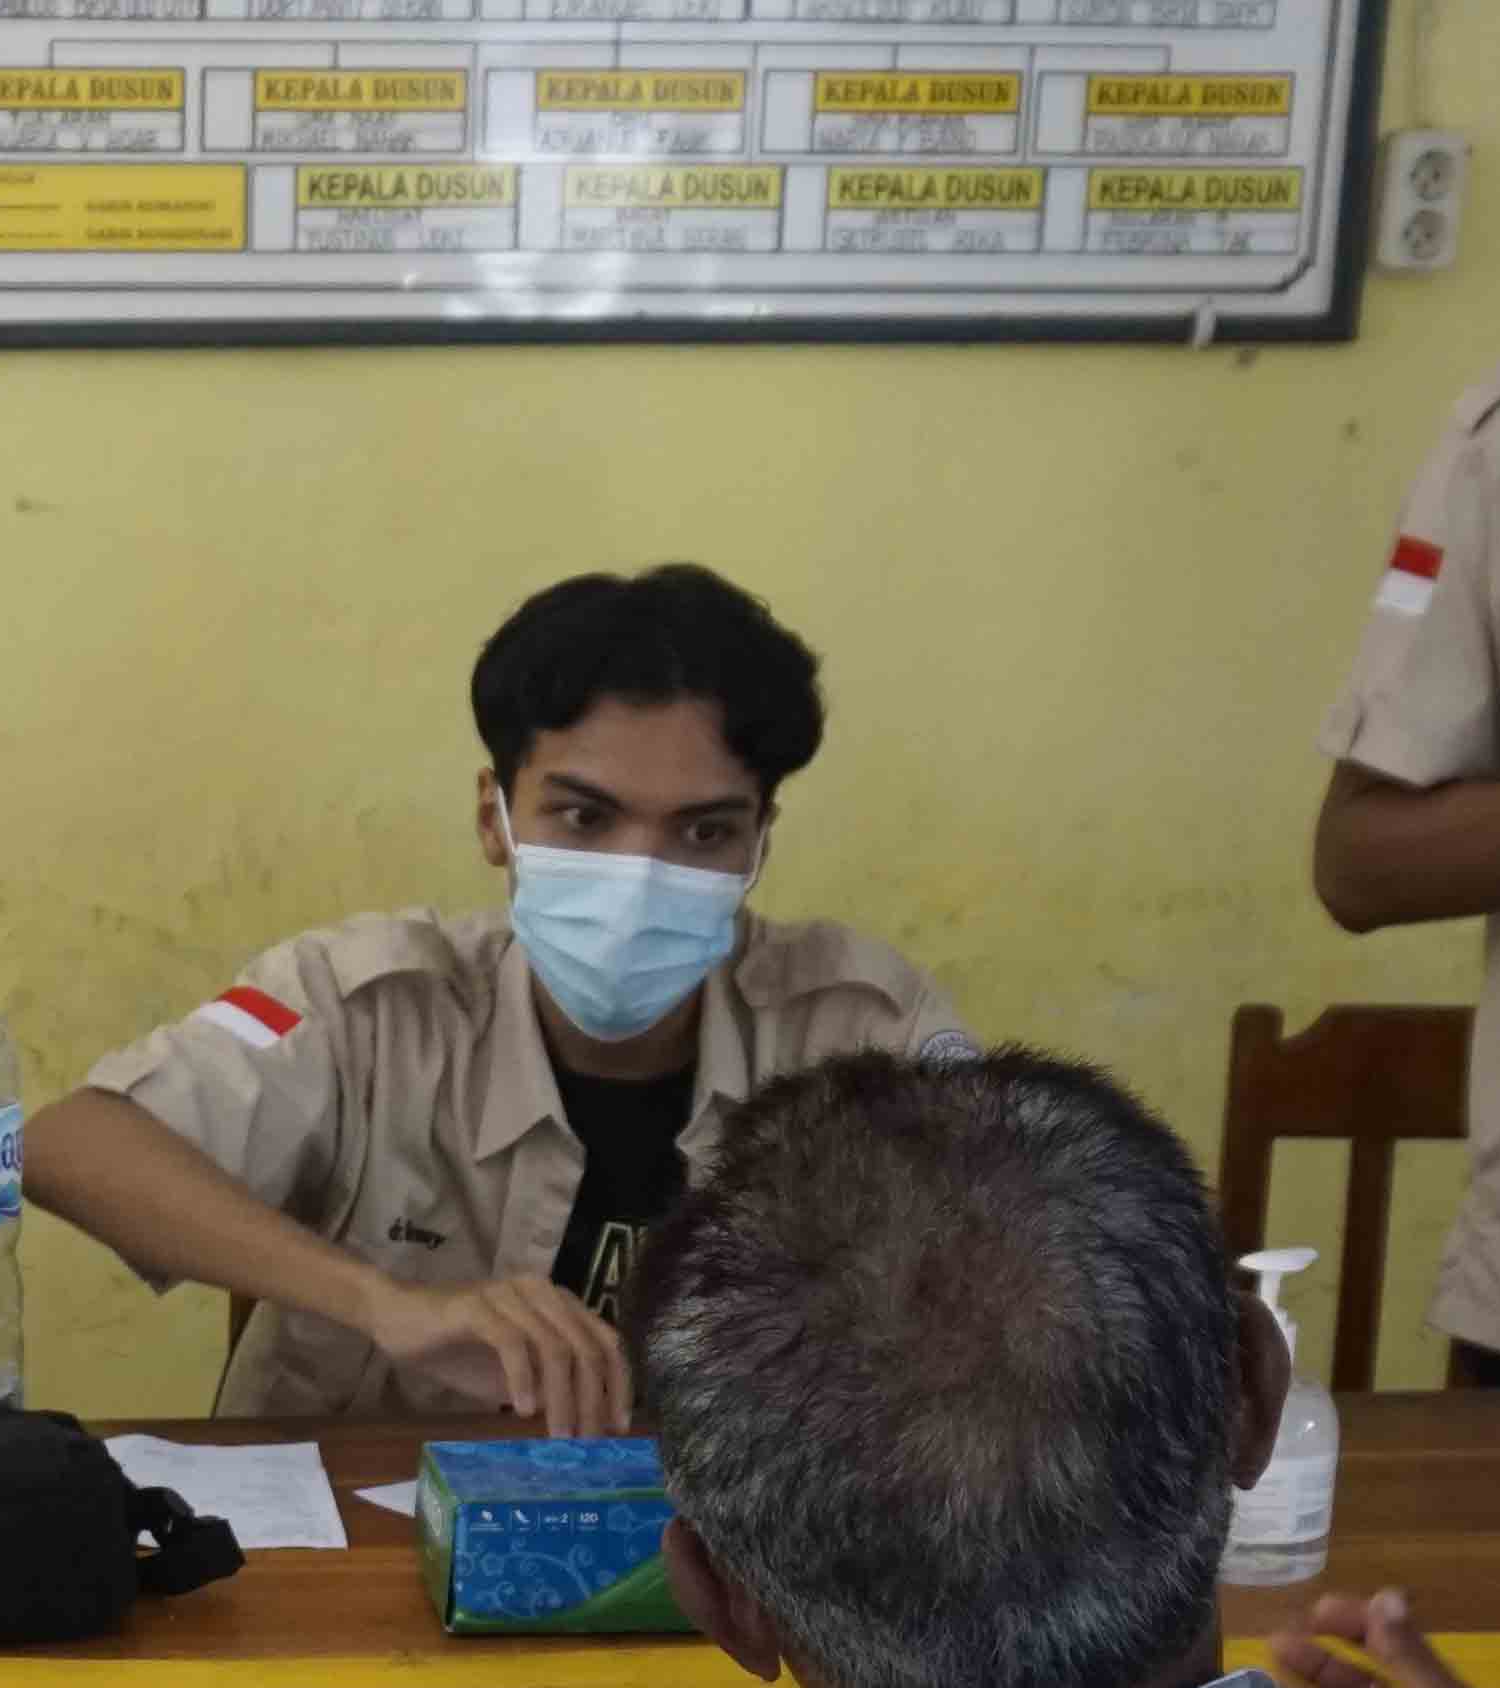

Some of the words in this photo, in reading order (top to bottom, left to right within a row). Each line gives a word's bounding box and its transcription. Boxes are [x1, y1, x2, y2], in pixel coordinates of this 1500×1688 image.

[88, 77, 174, 101] DUSUN
[263, 78, 363, 102] KEPALA
[374, 78, 457, 102] DUSUN
[546, 79, 644, 103] KEPALA
[652, 79, 737, 104] DUSUN
[823, 79, 920, 103] KEPALA
[928, 79, 1011, 103] DUSUN
[1096, 82, 1192, 105] KEPALA
[1201, 83, 1283, 106] DUSUN
[307, 172, 409, 201] KEPALA
[415, 172, 504, 200] DUSUN
[575, 172, 677, 201] KEPALA
[683, 172, 770, 201] DUSUN
[837, 173, 938, 202] KEPALA
[945, 174, 1032, 203] DUSUN
[1098, 176, 1197, 203] KEPALA
[1204, 176, 1292, 204] DUSUN
